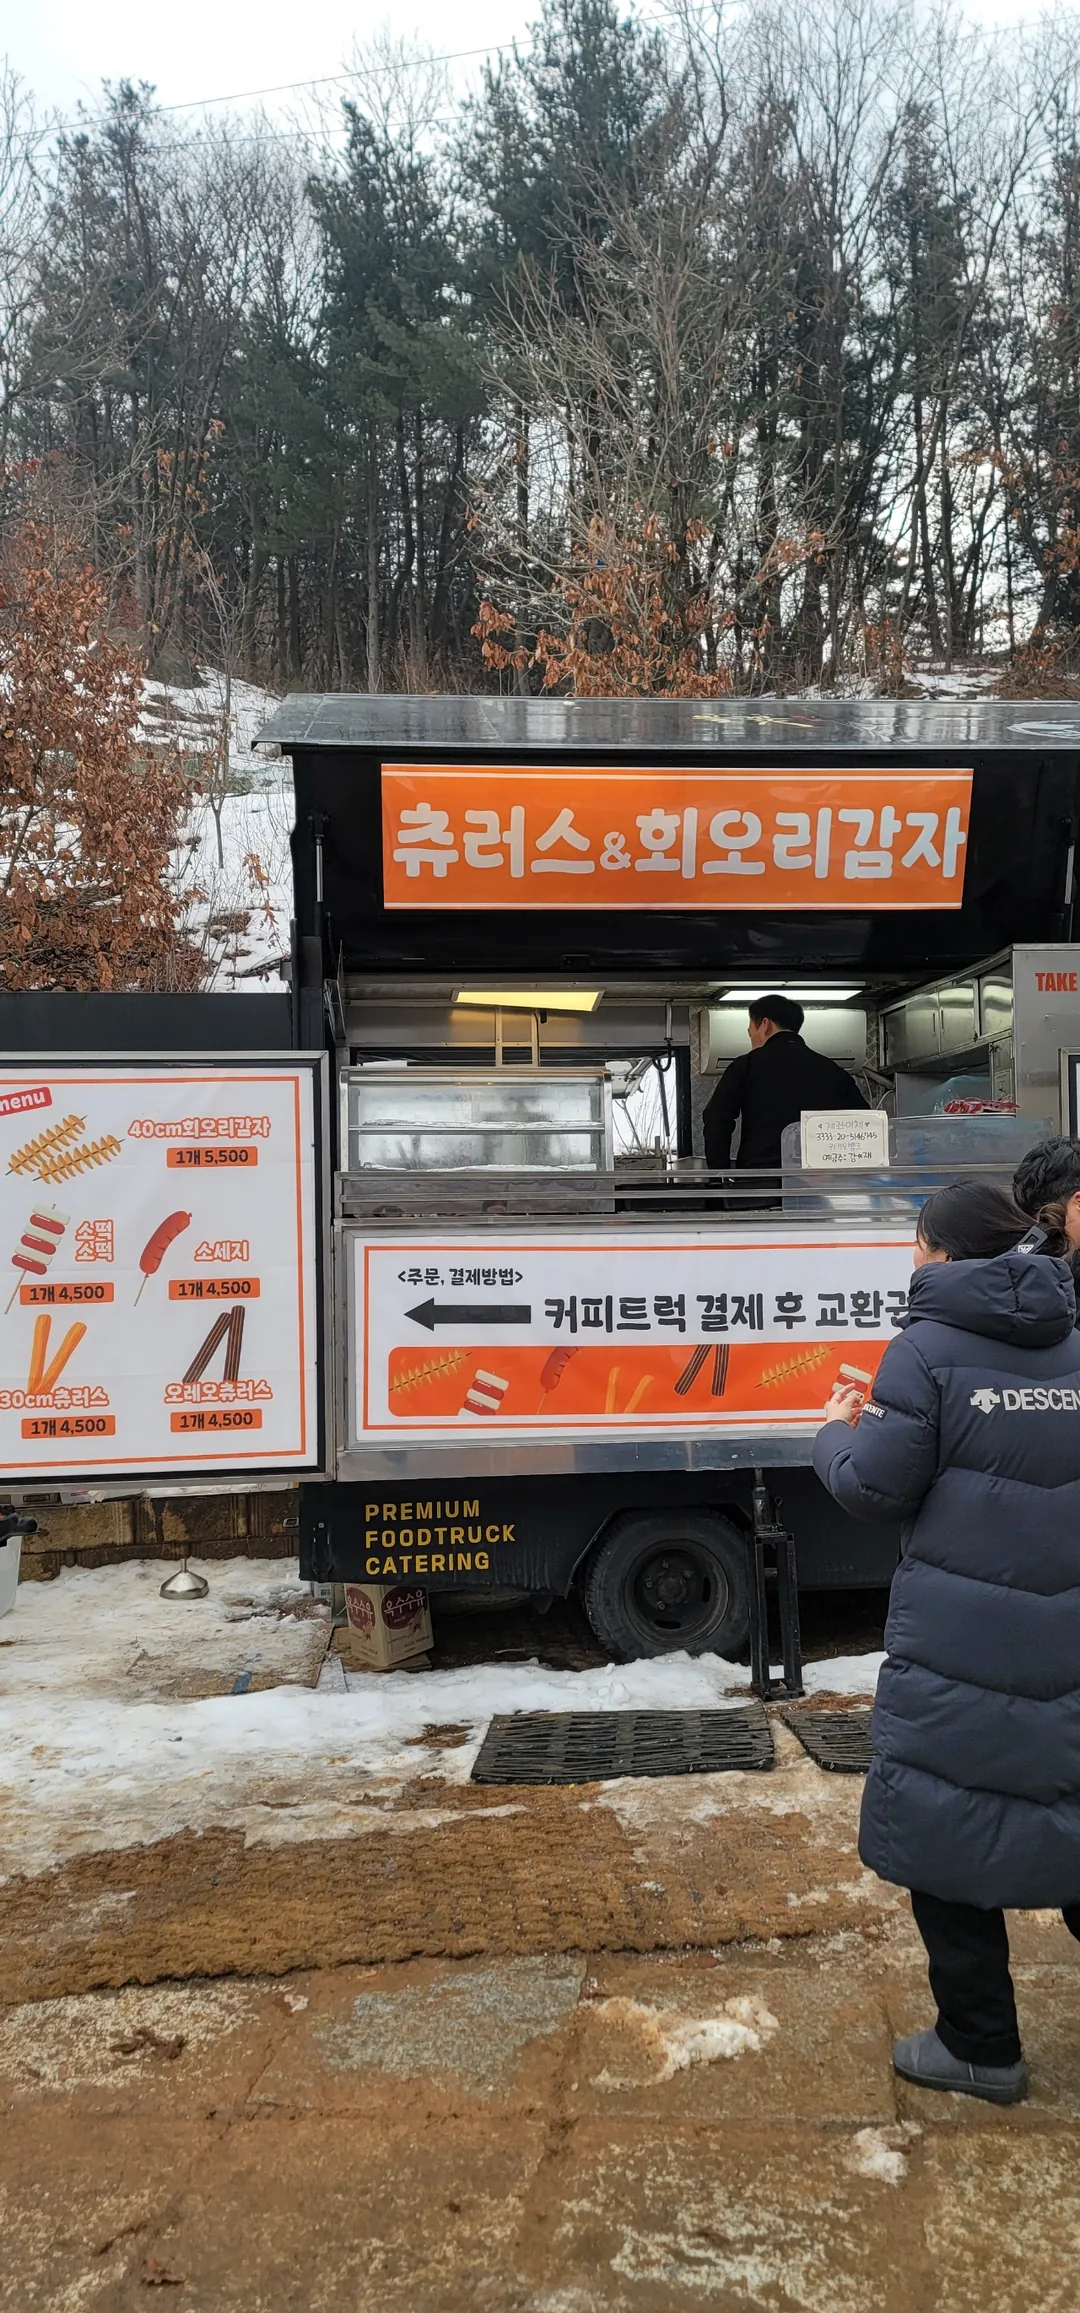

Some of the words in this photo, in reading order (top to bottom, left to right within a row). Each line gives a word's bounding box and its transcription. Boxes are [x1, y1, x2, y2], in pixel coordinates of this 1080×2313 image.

[393, 803, 965, 878] 츄러스&회오리감자
[1035, 973, 1077, 991] TAKE
[128, 1117, 271, 1138] 40cm회오리감자
[176, 1150, 200, 1165] 1개
[205, 1149, 248, 1164] 5,500
[75, 1220, 113, 1241] 소떡
[75, 1241, 113, 1262] 소떡
[194, 1240, 249, 1262] 소세지
[29, 1286, 54, 1301] 1개
[58, 1285, 104, 1300] 4,500
[178, 1282, 203, 1297] 1개
[206, 1281, 251, 1296] 4,500
[545, 1295, 686, 1333] 커피트럭
[697, 1291, 764, 1332] 결제
[773, 1294, 807, 1330] 후
[0, 1386, 109, 1409] 30cm츄러스
[164, 1380, 272, 1404] 오레오츄러스
[31, 1420, 56, 1435] 1개
[60, 1418, 106, 1435] 4,500
[180, 1414, 205, 1429] 1개
[208, 1412, 253, 1428] 4,500
[365, 1500, 480, 1522] PREMIUM
[365, 1524, 515, 1548] FOODTRUCK
[366, 1552, 490, 1575] CATERING
[384, 1590, 426, 1617] 옥수수유
